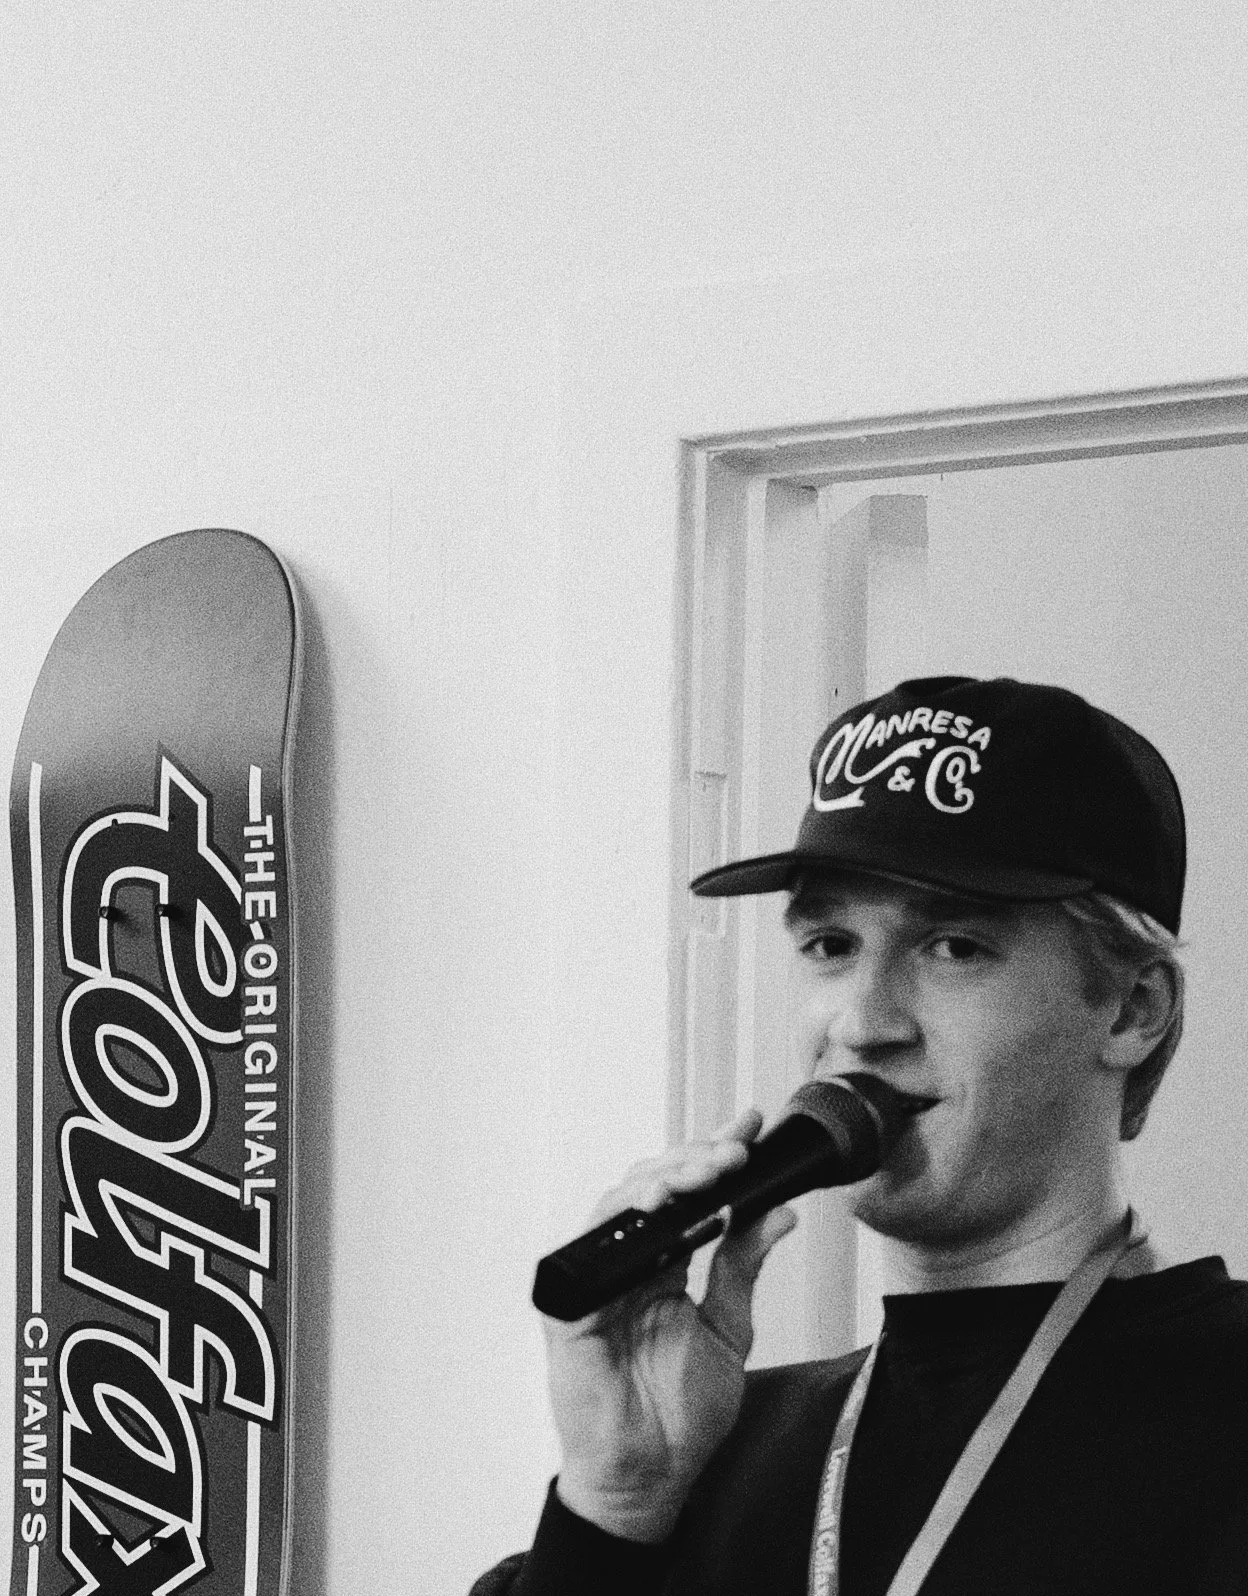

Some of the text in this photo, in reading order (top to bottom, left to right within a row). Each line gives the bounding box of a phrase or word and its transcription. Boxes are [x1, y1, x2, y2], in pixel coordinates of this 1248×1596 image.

[813, 707, 992, 812] MANRESA
[887, 765, 916, 792] &
[243, 815, 278, 1205] THE ORIGINAL
[21, 1315, 48, 1545] CHAMPS
